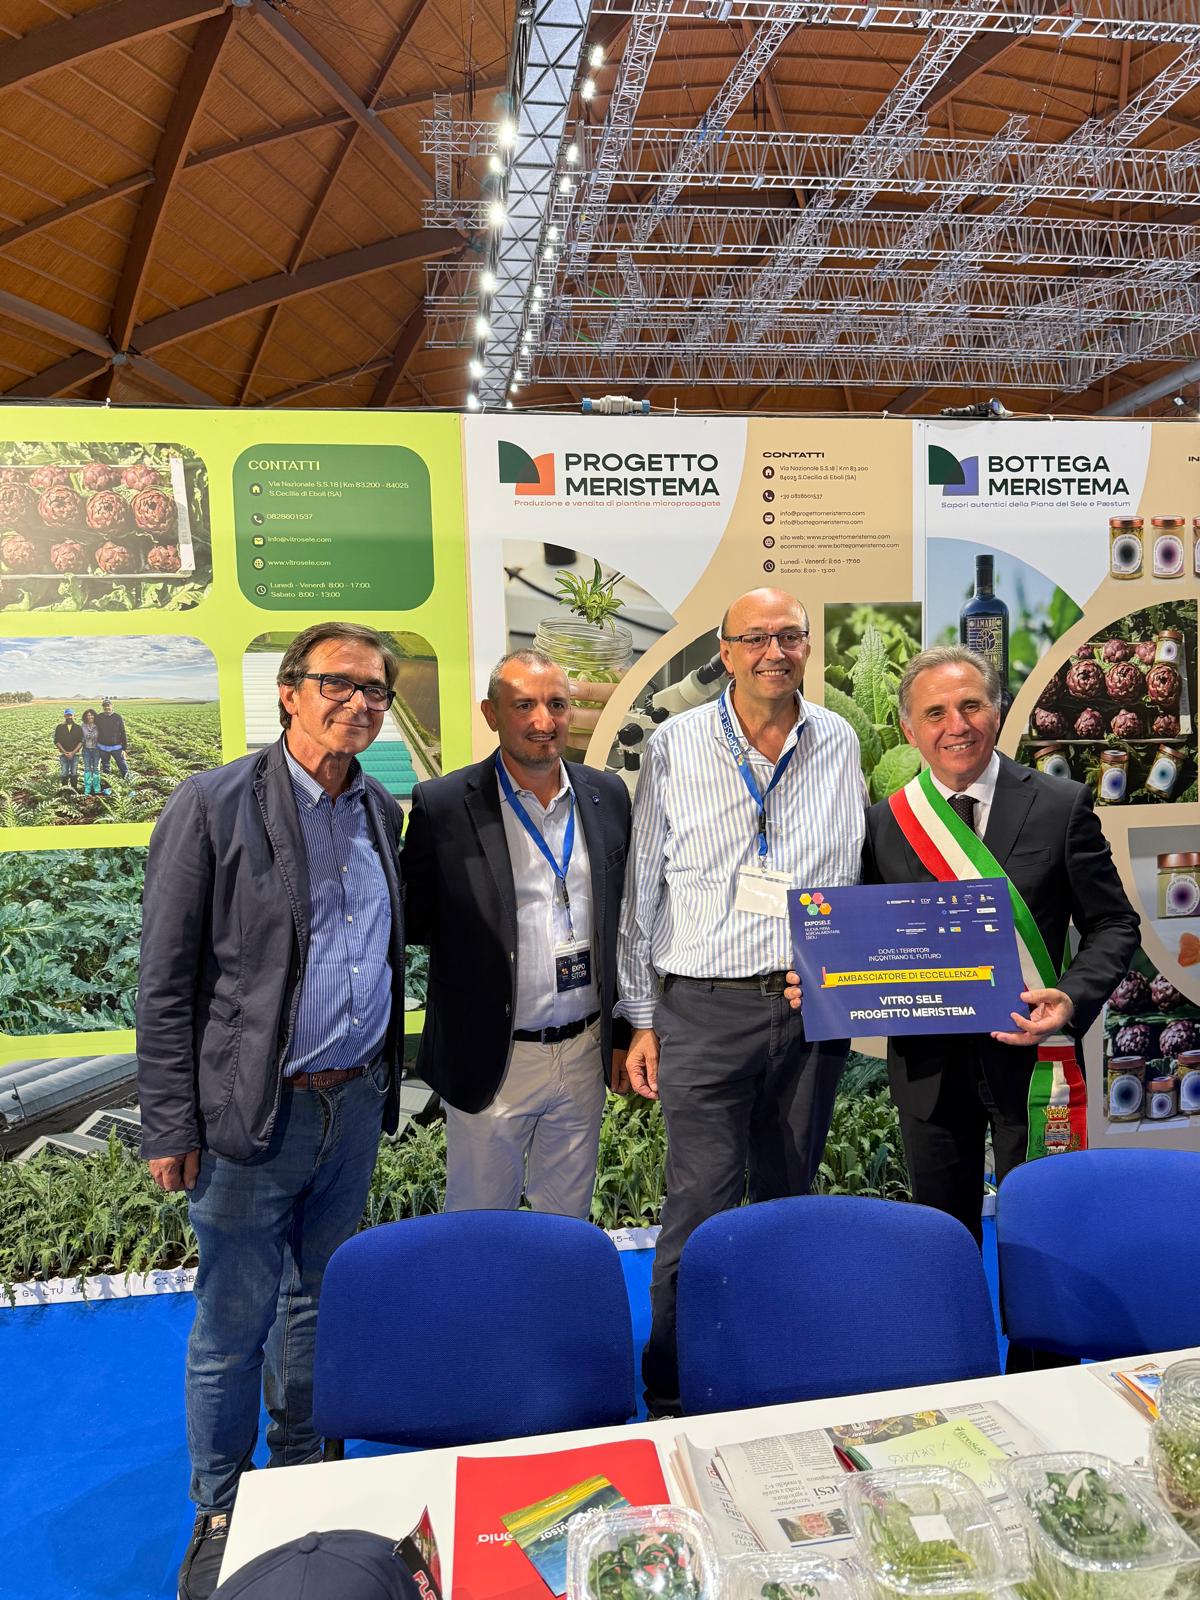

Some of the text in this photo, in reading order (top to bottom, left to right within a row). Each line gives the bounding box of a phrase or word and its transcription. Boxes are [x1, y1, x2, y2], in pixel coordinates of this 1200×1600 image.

[248, 460, 320, 471] CONTATTI
[565, 453, 718, 472] PROGETTO
[988, 456, 1110, 472] BOTTEGA
[566, 478, 720, 496] MERISTEMA
[988, 478, 1130, 496] MERISTEMA
[653, 500, 720, 508] micropropagate
[720, 711, 742, 757] EXPOSELE
[838, 972, 907, 983] AMBASCIATORE
[920, 970, 978, 979] ECCELLENZA
[880, 994, 942, 1006] VITRO SELE
[850, 1007, 976, 1020] PROGETTO MERISTEMA
